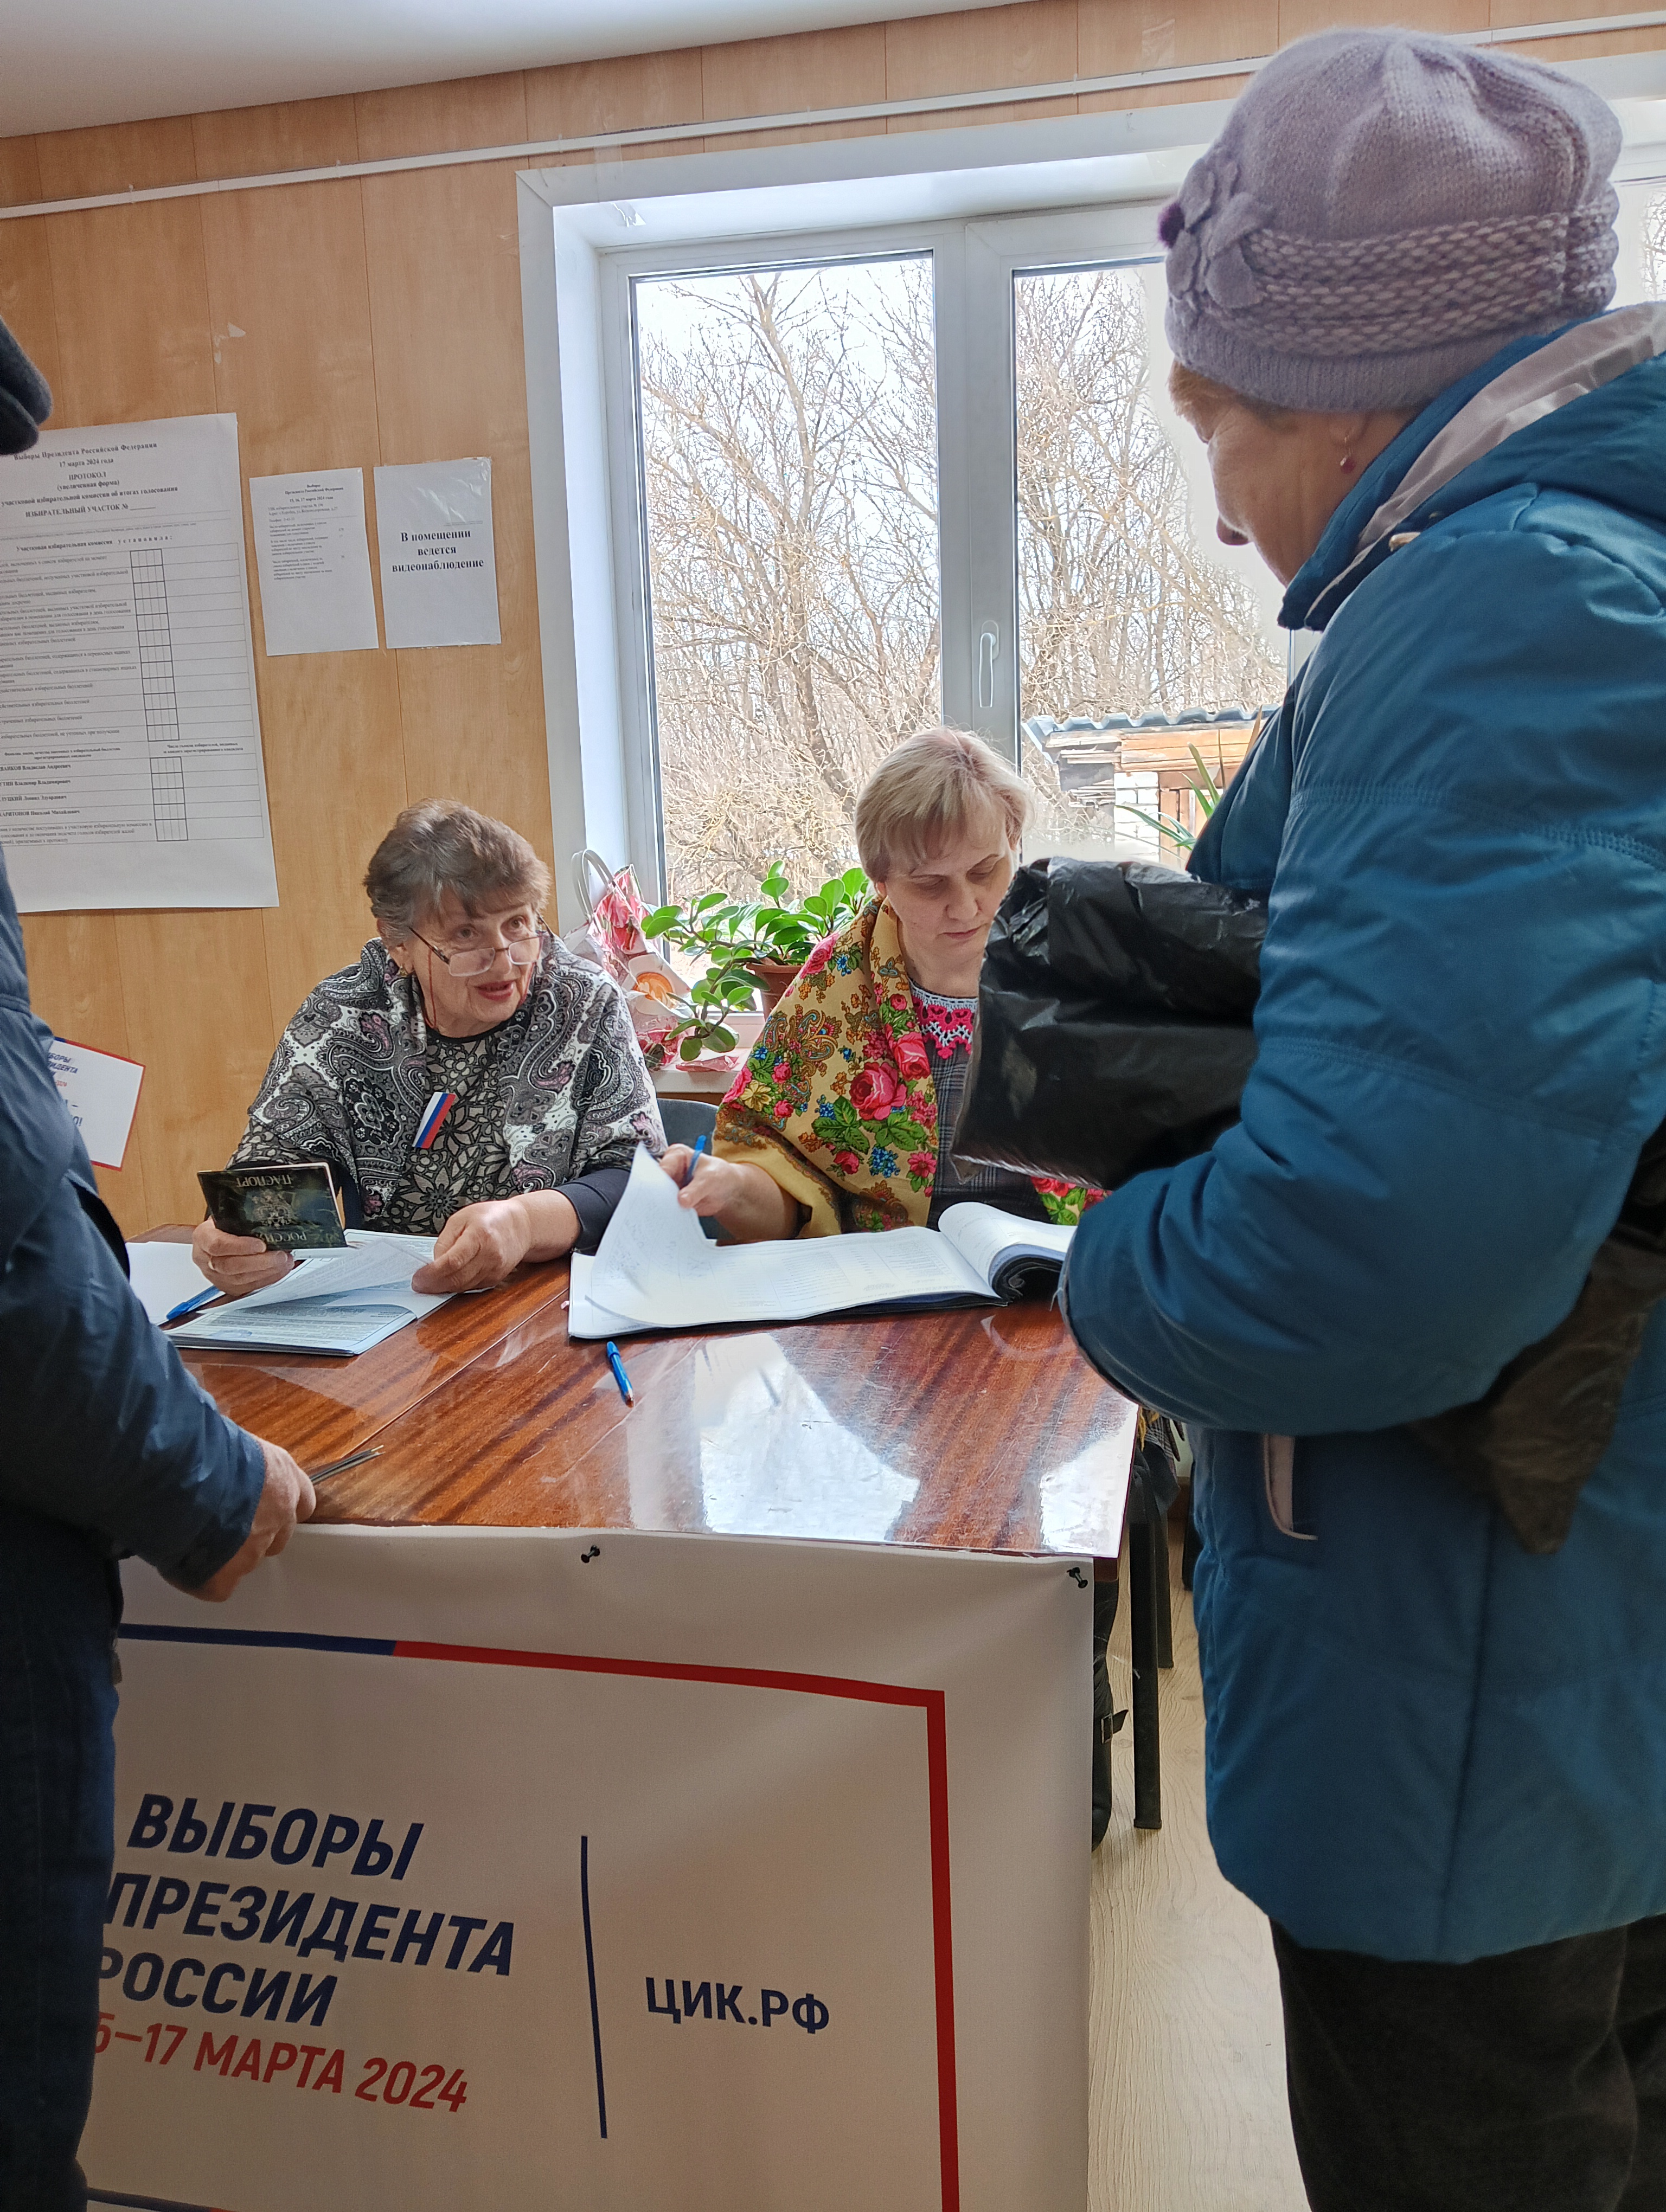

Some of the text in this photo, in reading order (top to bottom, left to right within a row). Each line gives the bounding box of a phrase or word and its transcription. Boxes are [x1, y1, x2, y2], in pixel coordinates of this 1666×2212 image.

[14, 442, 157, 461] Выборы Президента Российской Федерации
[69, 471, 106, 481] ПРОТОКОЛ
[57, 479, 120, 491] (увеличенная форма)
[36, 494, 80, 504] избирательной
[140, 486, 178, 494] голосования
[25, 506, 86, 518] ИЗБИРАТЕЛЬНЫЙ
[87, 504, 120, 513] УЧАСТОК
[401, 530, 471, 542] В помещении
[418, 546, 457, 556] ведется
[392, 559, 484, 573] видеонаблюдение
[48, 1053, 72, 1063] БОРЫ
[235, 1174, 292, 1187] ПАСПОРТ
[126, 1793, 425, 1880] ВЫБОРЫ
[106, 1872, 515, 1976] ПРЕЗИДЕНТА
[645, 1977, 830, 2035] ЦИК.РФ
[94, 2011, 468, 2113] 5–17 МАРТА 2024
